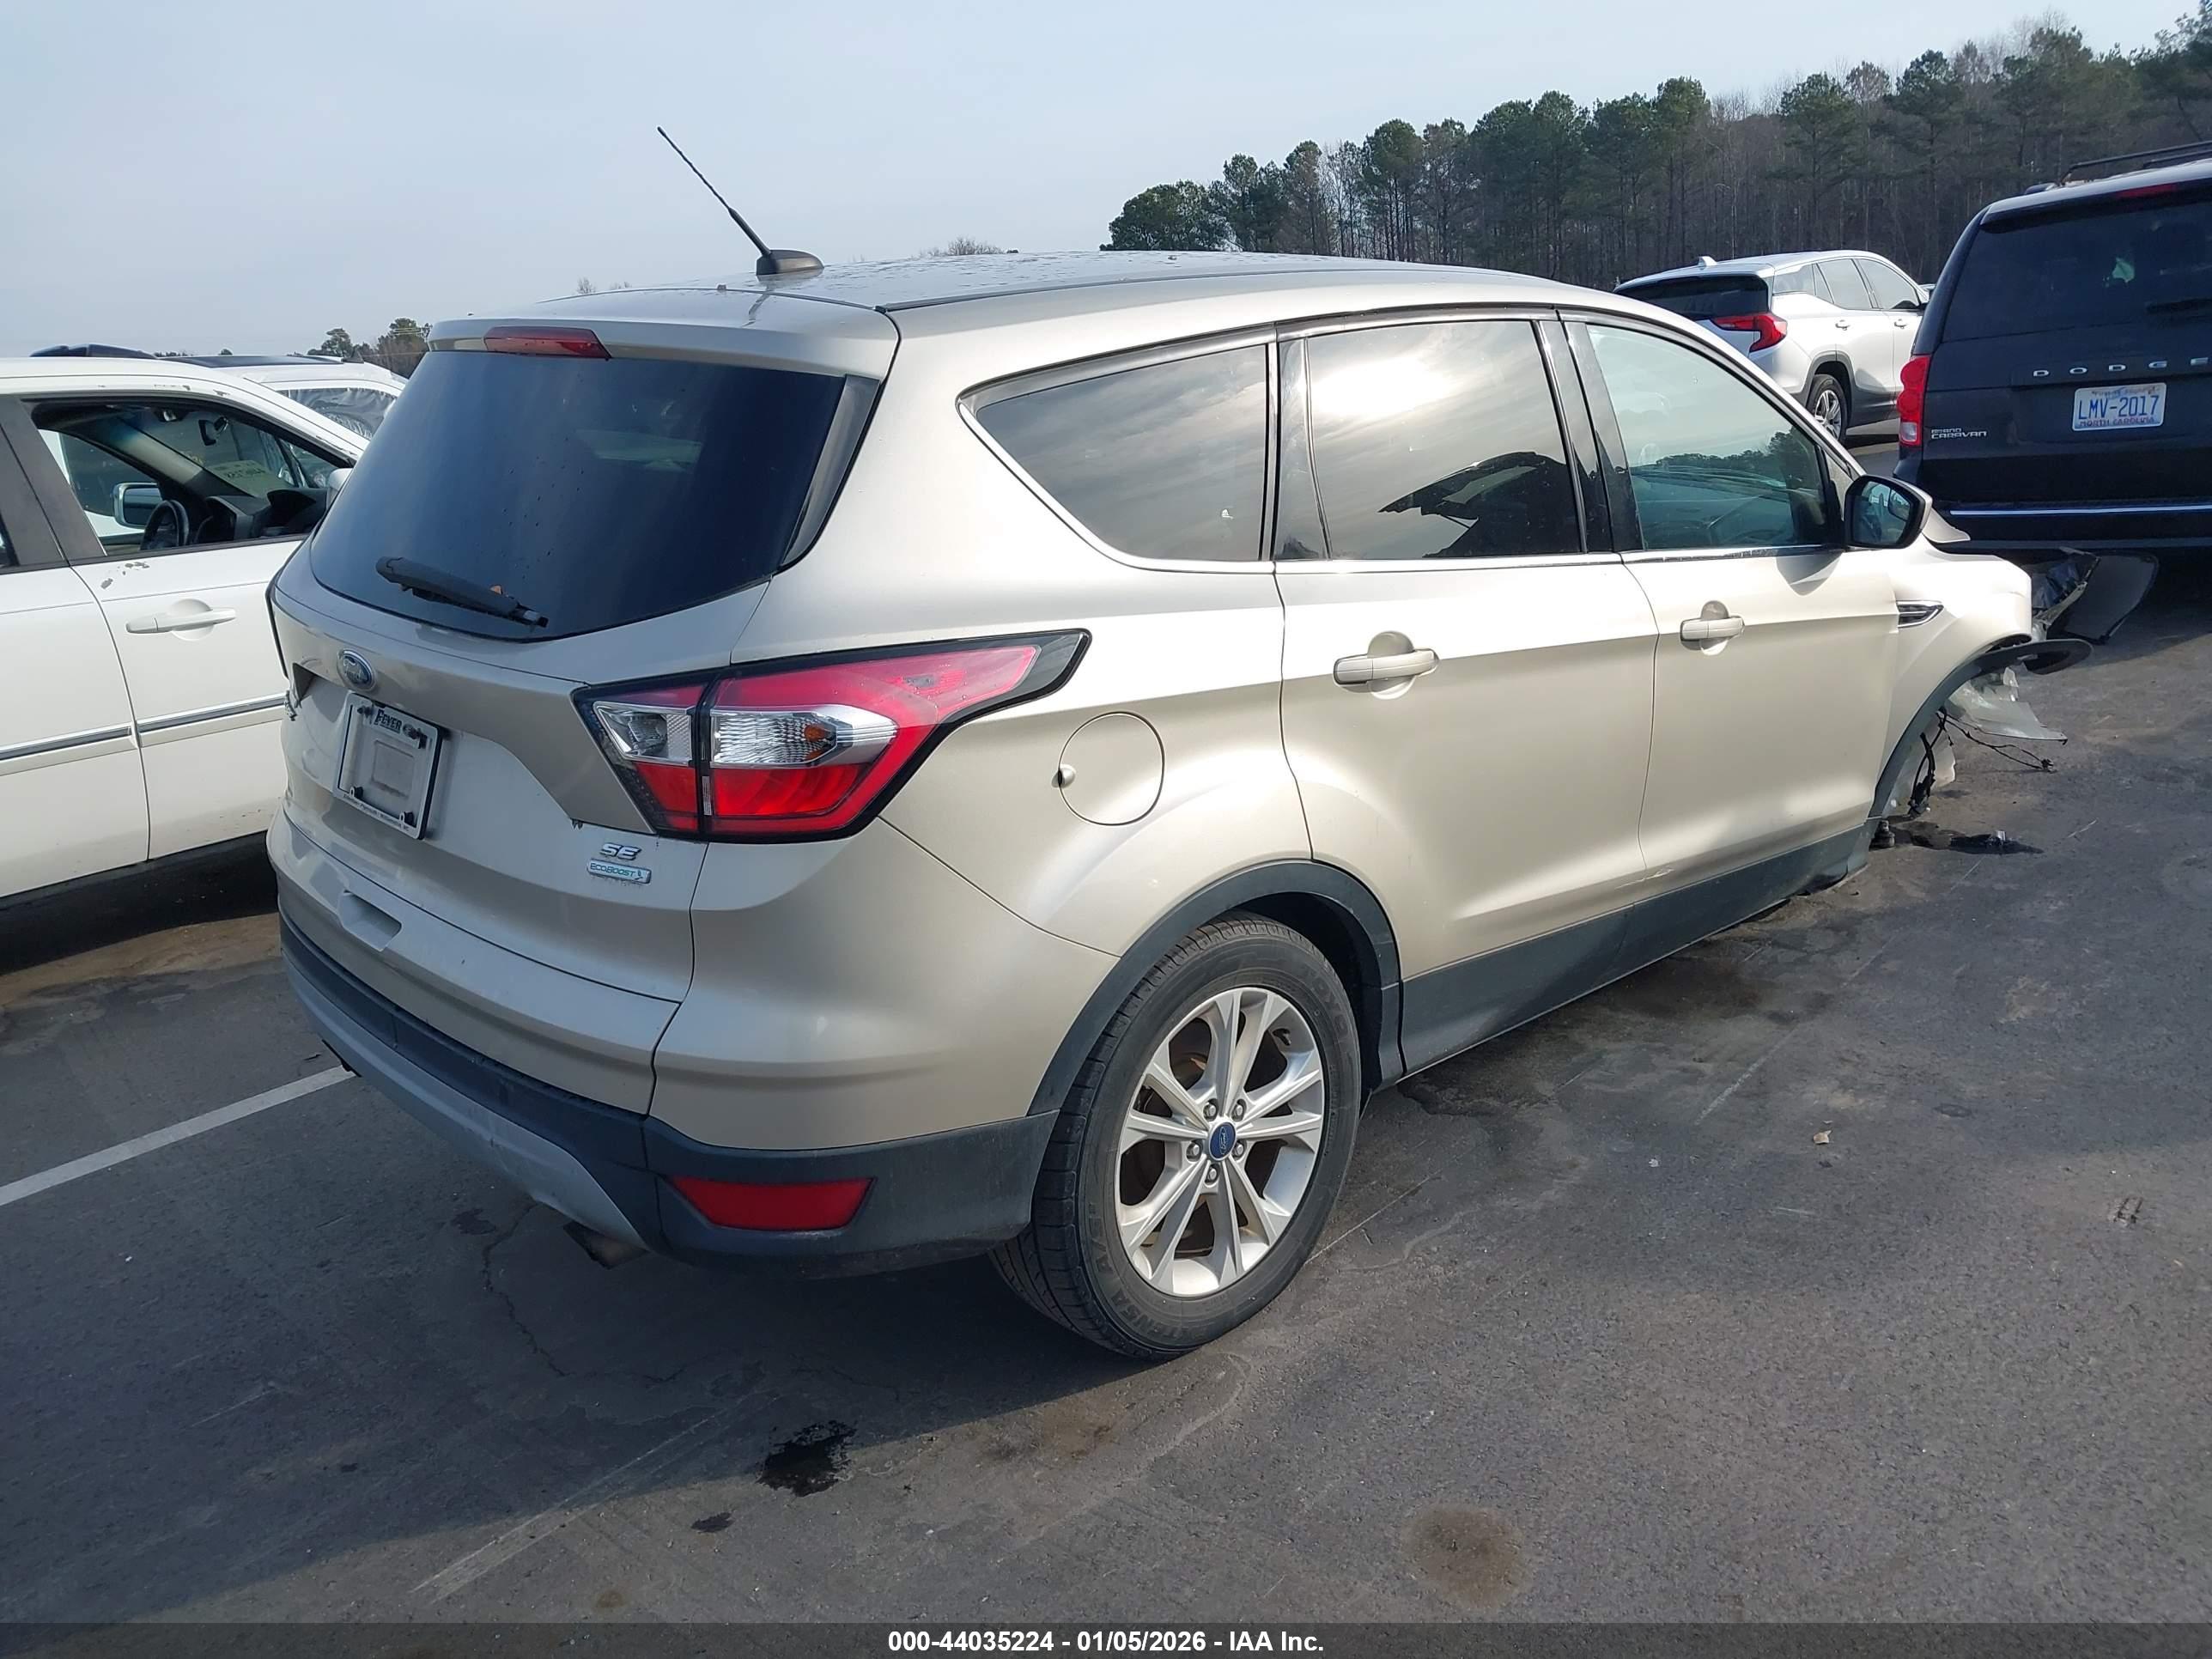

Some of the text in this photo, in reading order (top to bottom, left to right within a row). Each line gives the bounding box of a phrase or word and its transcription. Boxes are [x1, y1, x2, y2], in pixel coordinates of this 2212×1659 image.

[2033, 357, 2209, 377] DODGE
[2078, 395, 2160, 420] LMV-2017
[2080, 416, 2154, 427] NORTH CAROLINA
[1931, 431, 1987, 440] CARAVAN
[599, 842, 641, 860] SE
[590, 862, 636, 878] ECOBOOST
